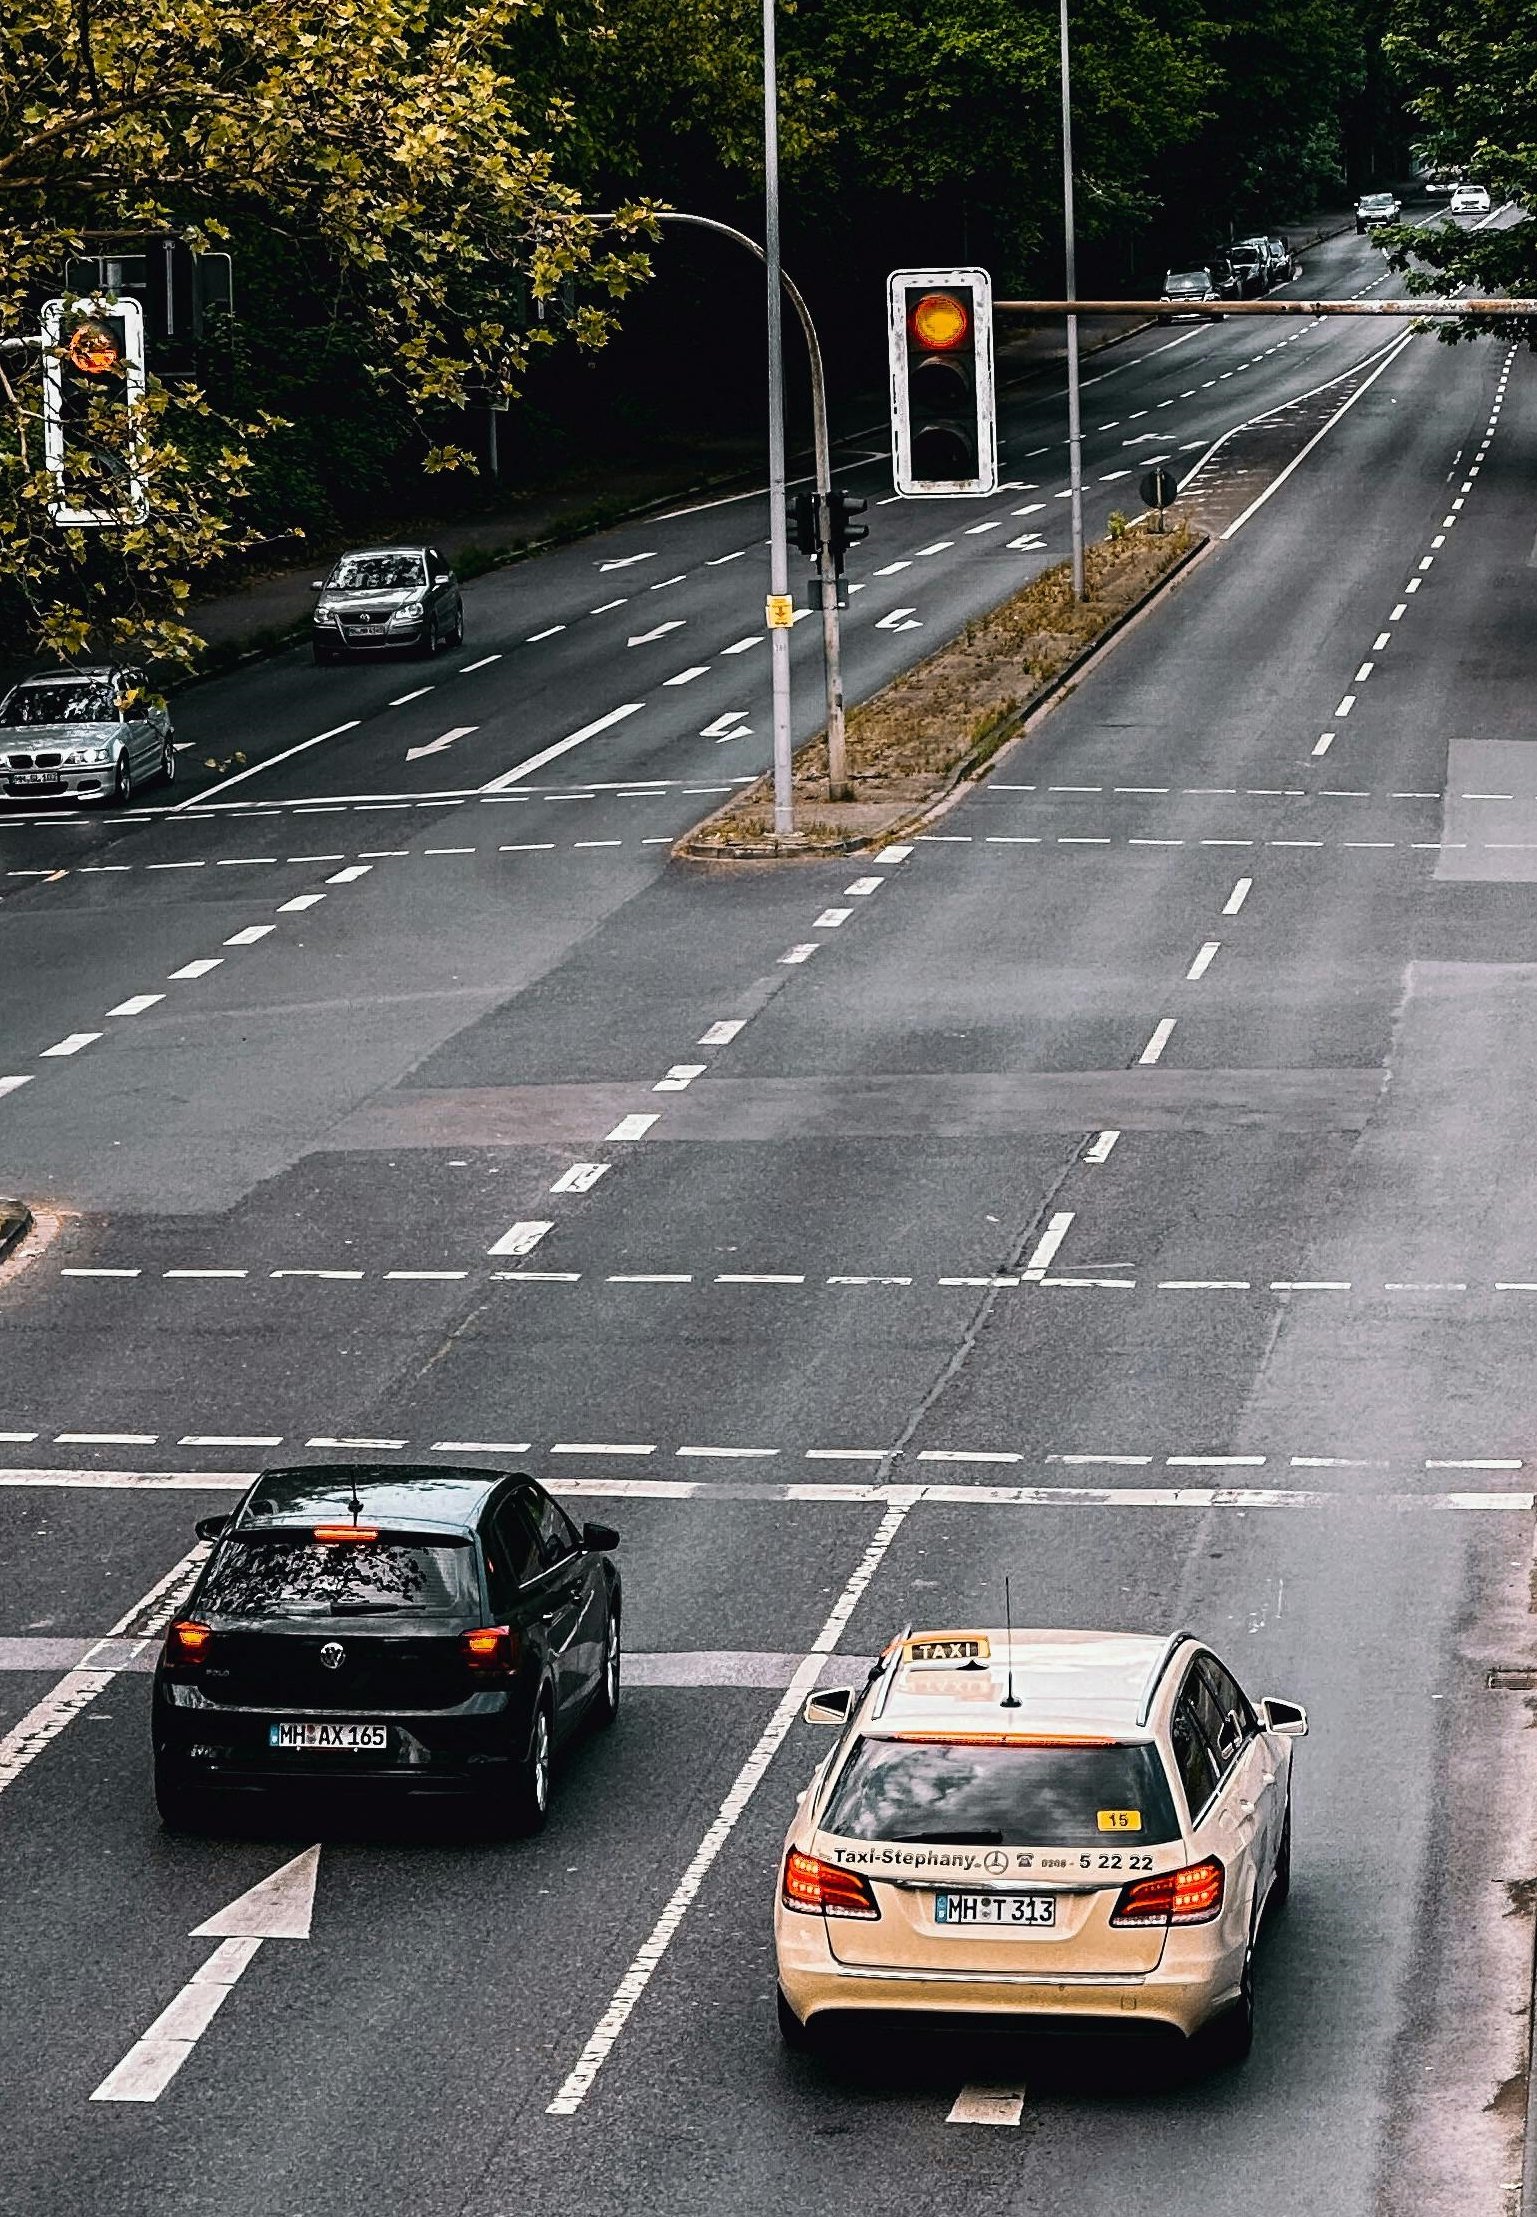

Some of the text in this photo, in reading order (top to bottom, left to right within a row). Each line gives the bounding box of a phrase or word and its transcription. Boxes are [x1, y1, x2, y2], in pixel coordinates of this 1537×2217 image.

[919, 1642, 971, 1660] TAXI
[280, 1724, 385, 1746] MH AX 165
[1109, 1812, 1129, 1827] 15
[1079, 1852, 1091, 1869] 5
[1097, 1853, 1123, 1870] 22
[1128, 1854, 1154, 1871] 22
[948, 1897, 1053, 1922] MH T 313
